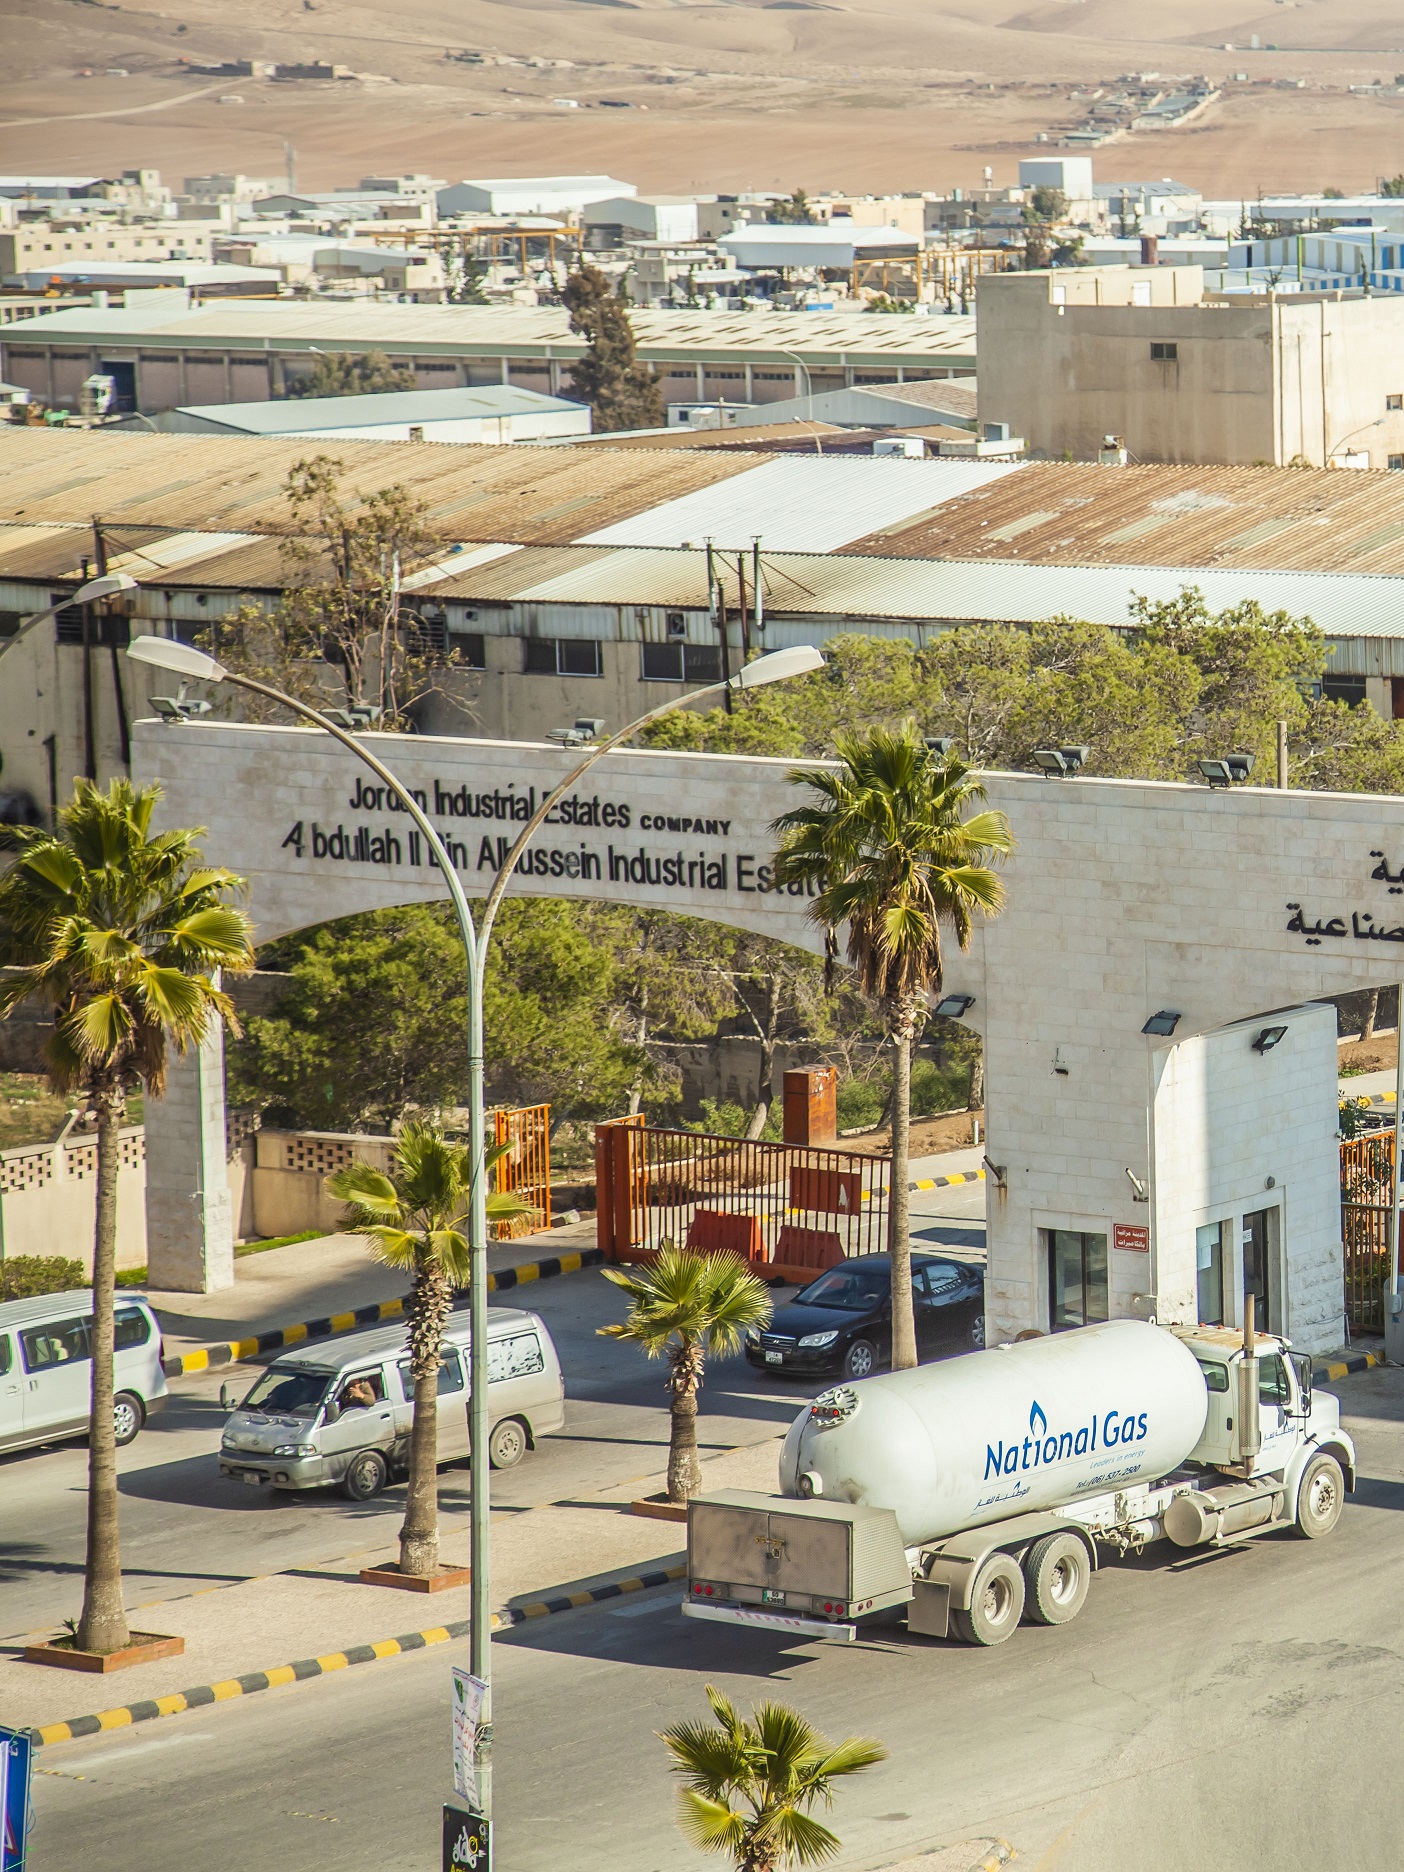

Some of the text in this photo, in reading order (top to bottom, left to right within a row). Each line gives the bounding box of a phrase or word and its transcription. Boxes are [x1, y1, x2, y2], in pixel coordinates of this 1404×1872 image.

[434, 779, 535, 821] Industrial
[542, 791, 630, 829] Estates
[640, 814, 731, 836] COMPANY
[608, 844, 727, 890] Industrial
[983, 1411, 1148, 1480] National Gas
[1123, 1449, 1146, 1461] energy
